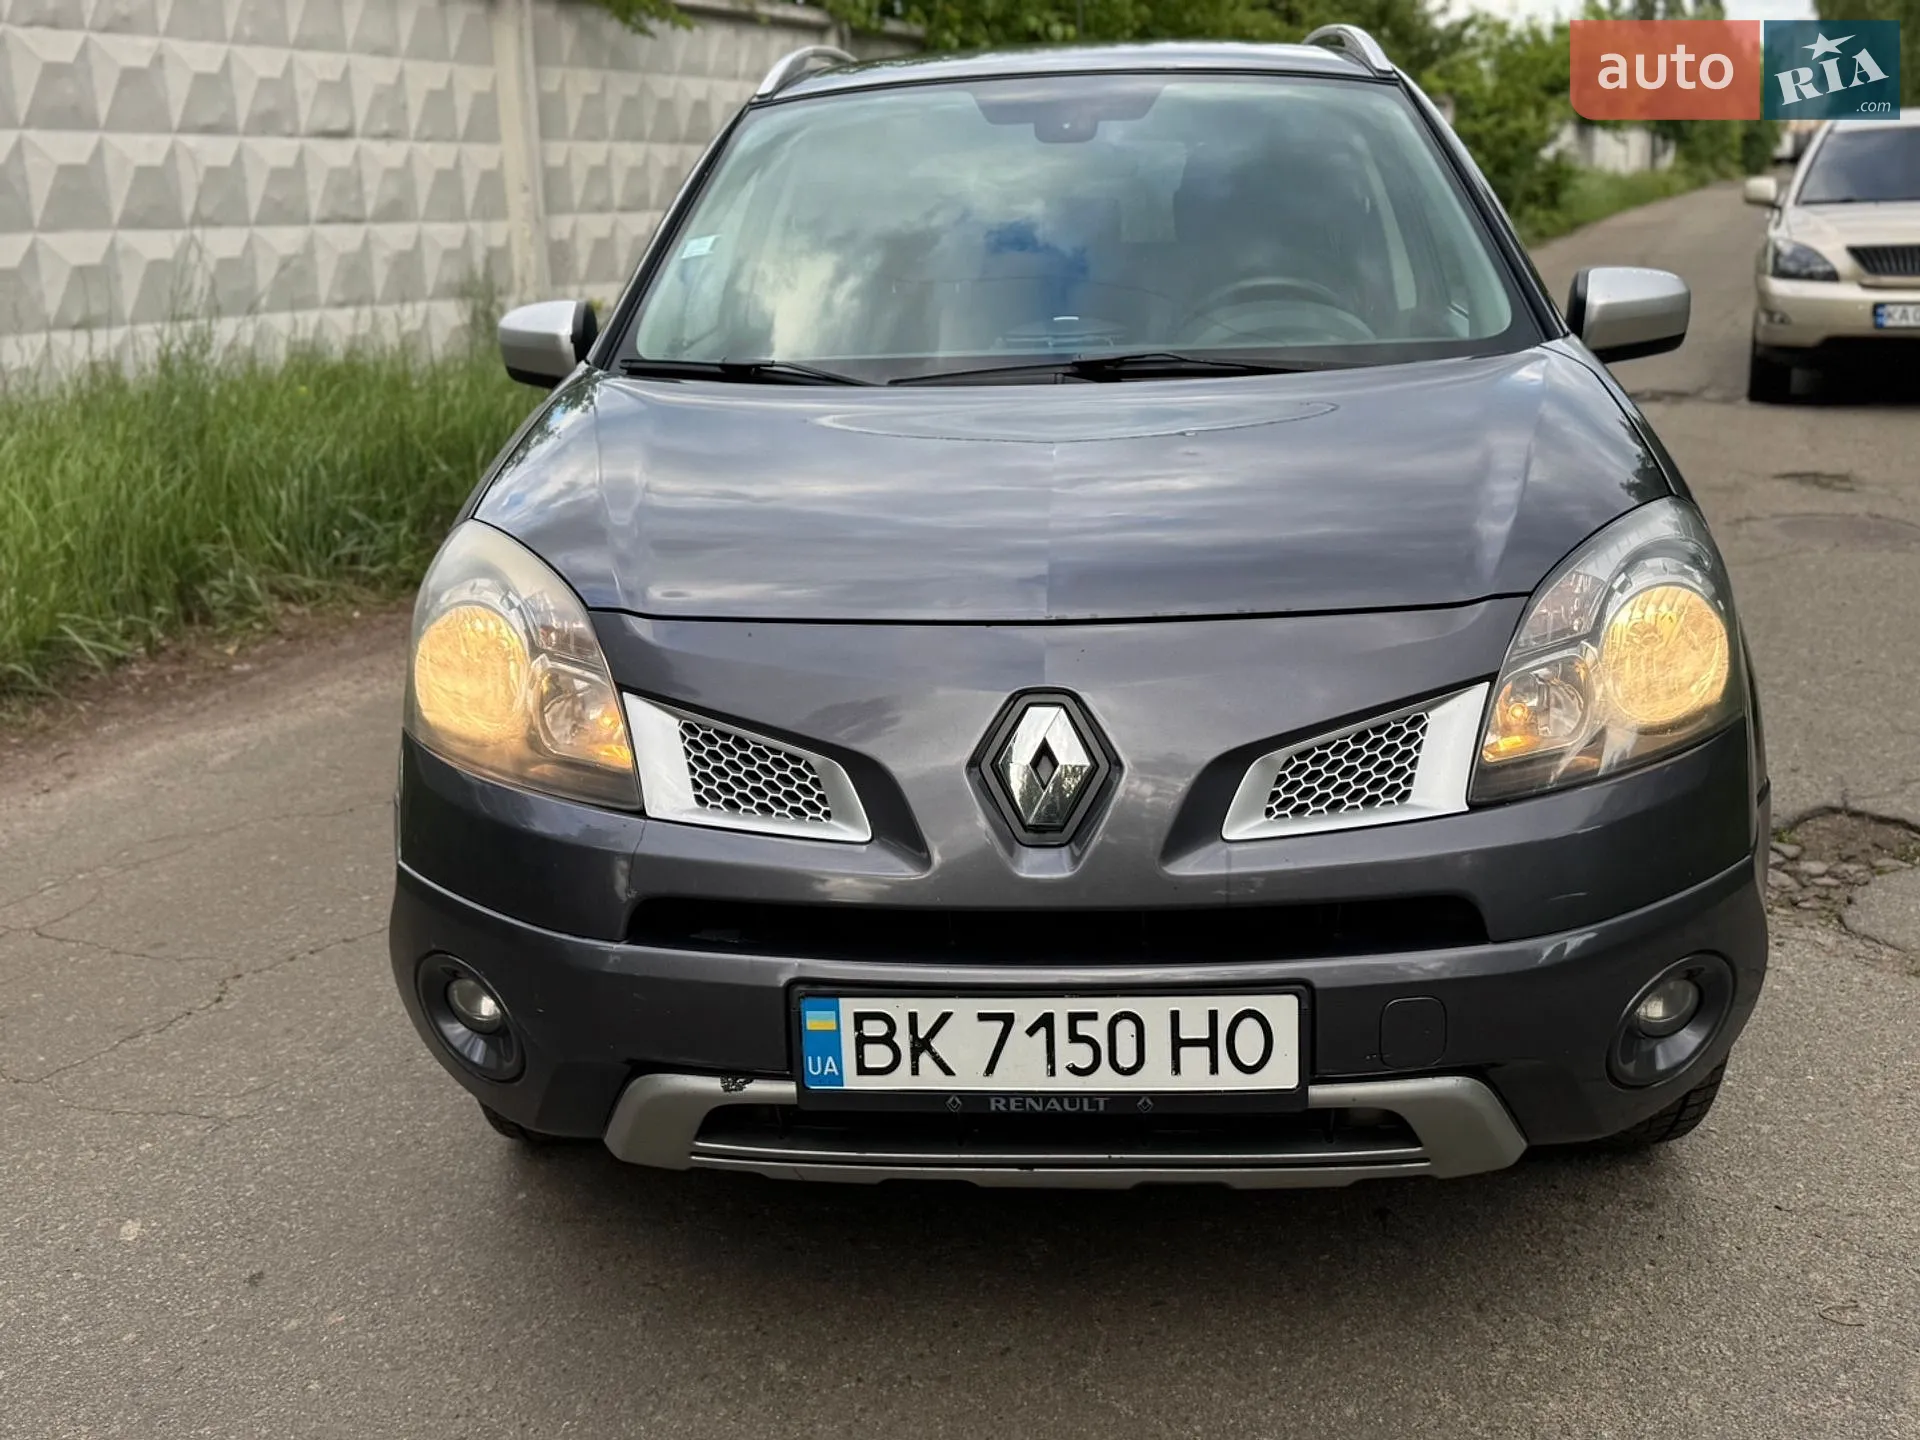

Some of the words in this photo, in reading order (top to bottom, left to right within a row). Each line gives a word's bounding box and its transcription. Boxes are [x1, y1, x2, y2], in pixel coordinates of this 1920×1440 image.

[853, 1011, 956, 1077] BK
[977, 1010, 1146, 1077] 7150
[1169, 1008, 1274, 1076] HO
[808, 1056, 839, 1075] UA
[990, 1097, 1110, 1112] RENAULT
